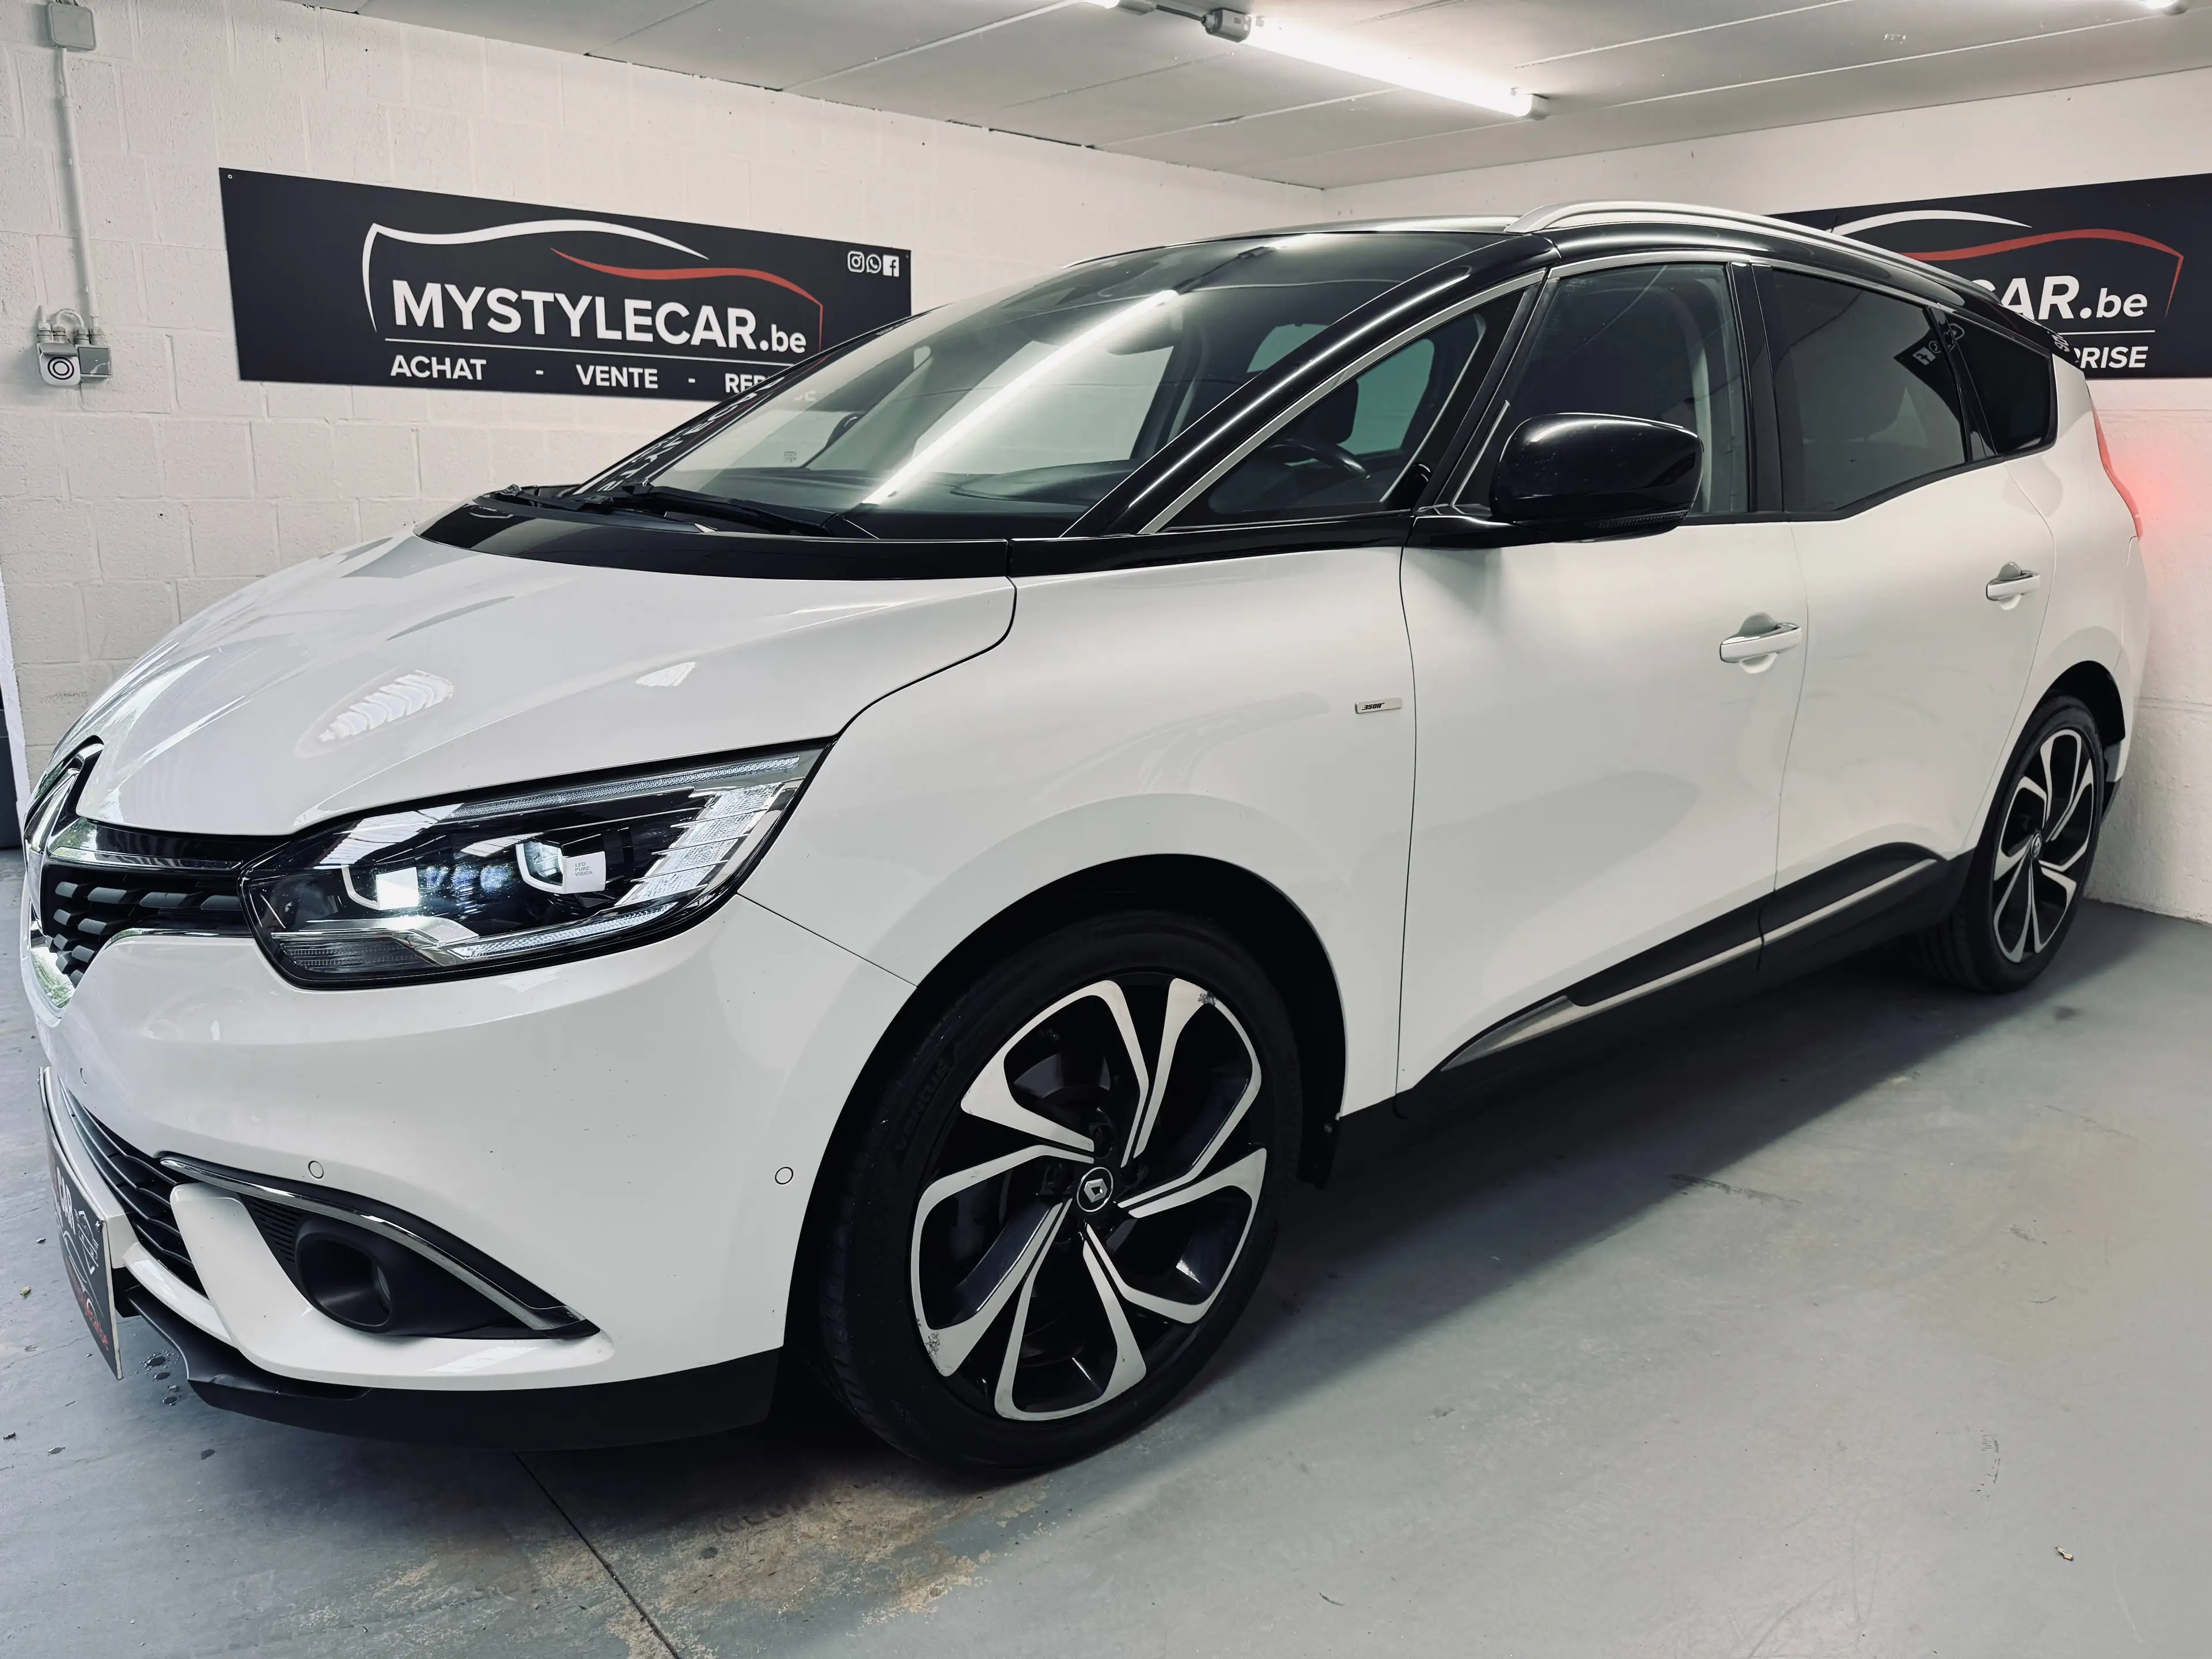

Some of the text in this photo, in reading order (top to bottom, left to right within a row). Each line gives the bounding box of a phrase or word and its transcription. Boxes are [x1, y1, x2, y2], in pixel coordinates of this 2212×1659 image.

[392, 279, 807, 354] MYSTYLECAR.be
[390, 354, 487, 380] ACHAT
[575, 363, 658, 389] VENTE
